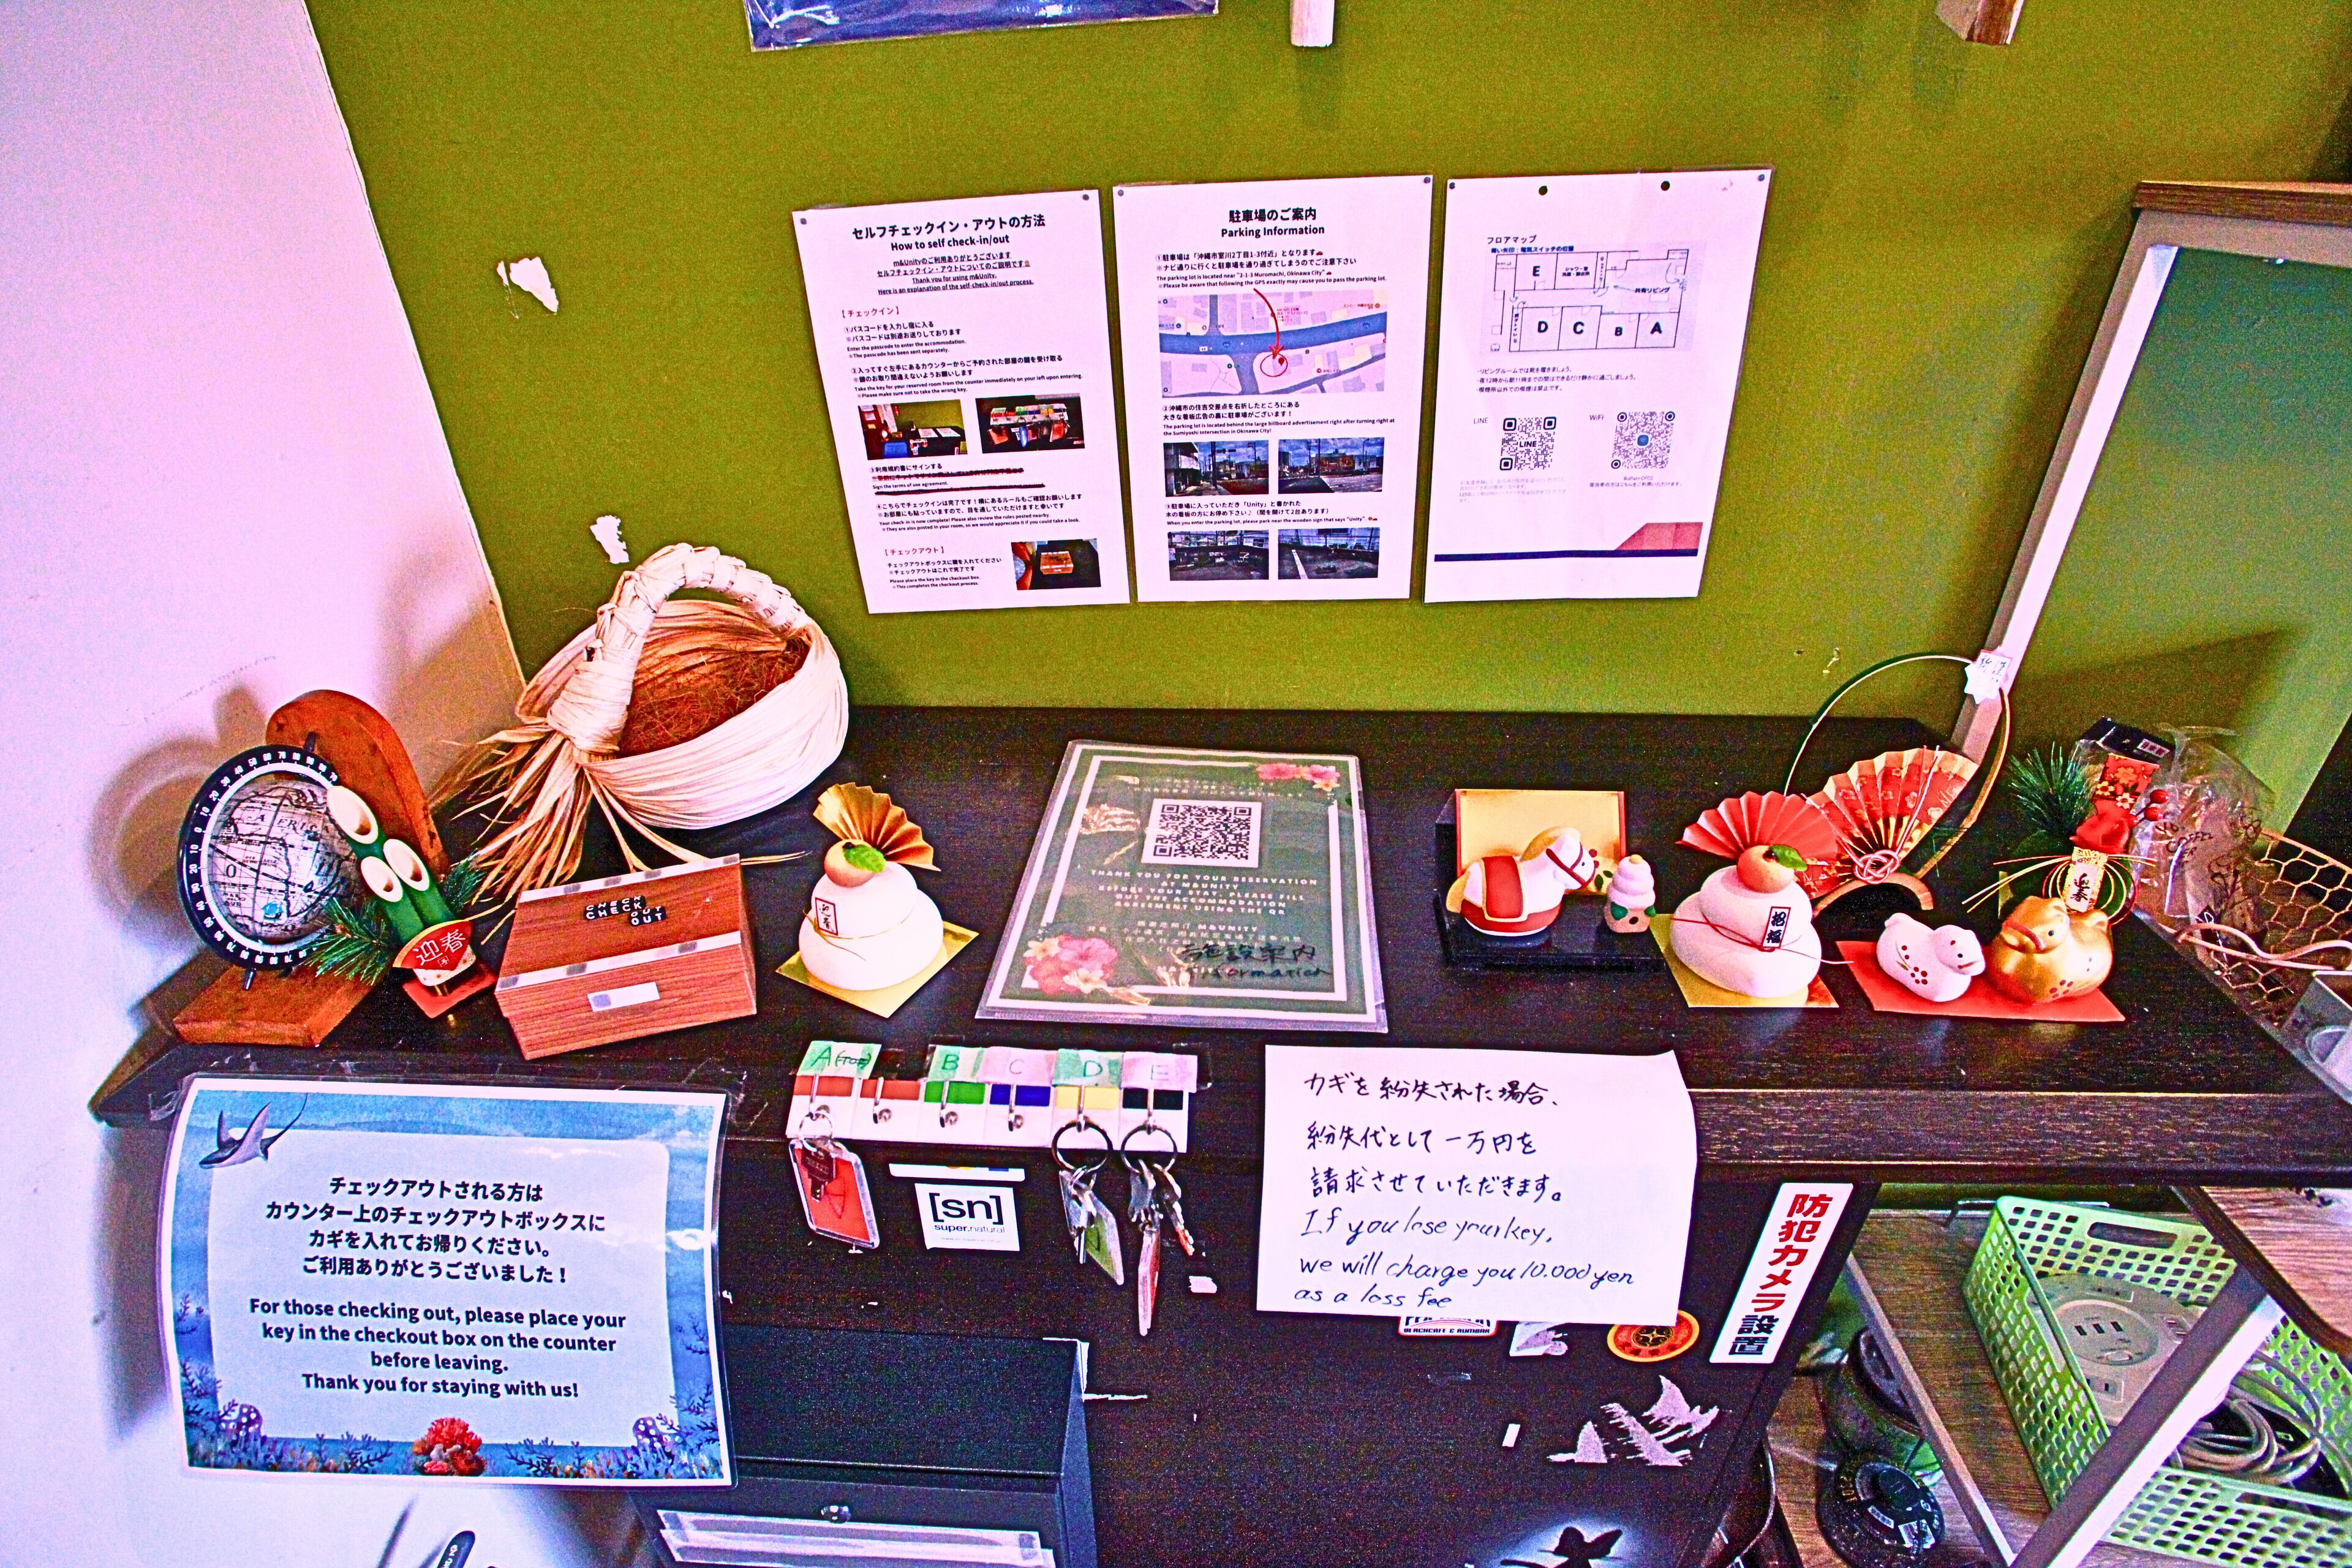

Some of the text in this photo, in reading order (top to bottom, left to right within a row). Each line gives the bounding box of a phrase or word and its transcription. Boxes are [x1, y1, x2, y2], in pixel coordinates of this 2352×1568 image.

[1228, 206, 1316, 224] 駐車場のご案内
[851, 213, 1046, 240] セルフチェックイン・アウトの方法
[1221, 224, 1325, 239] Parking Information
[891, 234, 1010, 251] How to self check-in/out
[1487, 235, 1537, 244] フロアマップ
[1532, 266, 1540, 276] E
[1537, 321, 1548, 333] D
[1573, 321, 1585, 334] C
[1615, 326, 1623, 336] B
[1650, 322, 1663, 334] A
[200, 807, 210, 816] 10
[190, 845, 200, 854] 10
[189, 864, 199, 874] 20
[1233, 876, 1317, 885] RESERVATION
[586, 902, 642, 919] CHECK
[1174, 897, 1286, 908] ACCOMMODATION
[631, 913, 662, 925] OUT
[413, 929, 466, 966] 迎春
[810, 1047, 831, 1066] A
[941, 1054, 960, 1071] B
[1009, 1059, 1023, 1075] C
[1083, 1061, 1103, 1077] D
[1150, 1064, 1169, 1080] E
[330, 1177, 542, 1202] チェックアウトされる方は
[1311, 1168, 1563, 1203] 請求させていただきます。
[265, 1201, 605, 1231] カウンター上のチェックアウトボックスに
[929, 1193, 1003, 1225] [sn]
[934, 1224, 1005, 1233] super.natural
[1300, 1207, 1342, 1237] If
[1347, 1216, 1400, 1246] you
[1402, 1206, 1448, 1236] lose
[308, 1229, 548, 1257] カギを入れてお帰りください。
[303, 1255, 565, 1283] ご利用ありがとうございました！
[1299, 1257, 1332, 1274] we
[1342, 1251, 1384, 1276] will
[1385, 1261, 1468, 1287] charge
[1472, 1264, 1517, 1287] you
[1591, 1268, 1634, 1289] yen
[1728, 1194, 1833, 1355] 防犯カメラ設置
[1294, 1283, 1453, 1309] as a loss fee
[250, 1298, 626, 1330] For those checking out, please place your
[262, 1322, 616, 1351] key in the checkout box on the counter
[371, 1351, 508, 1374] before leaving.
[301, 1373, 578, 1398] Thank you for staying with us!
